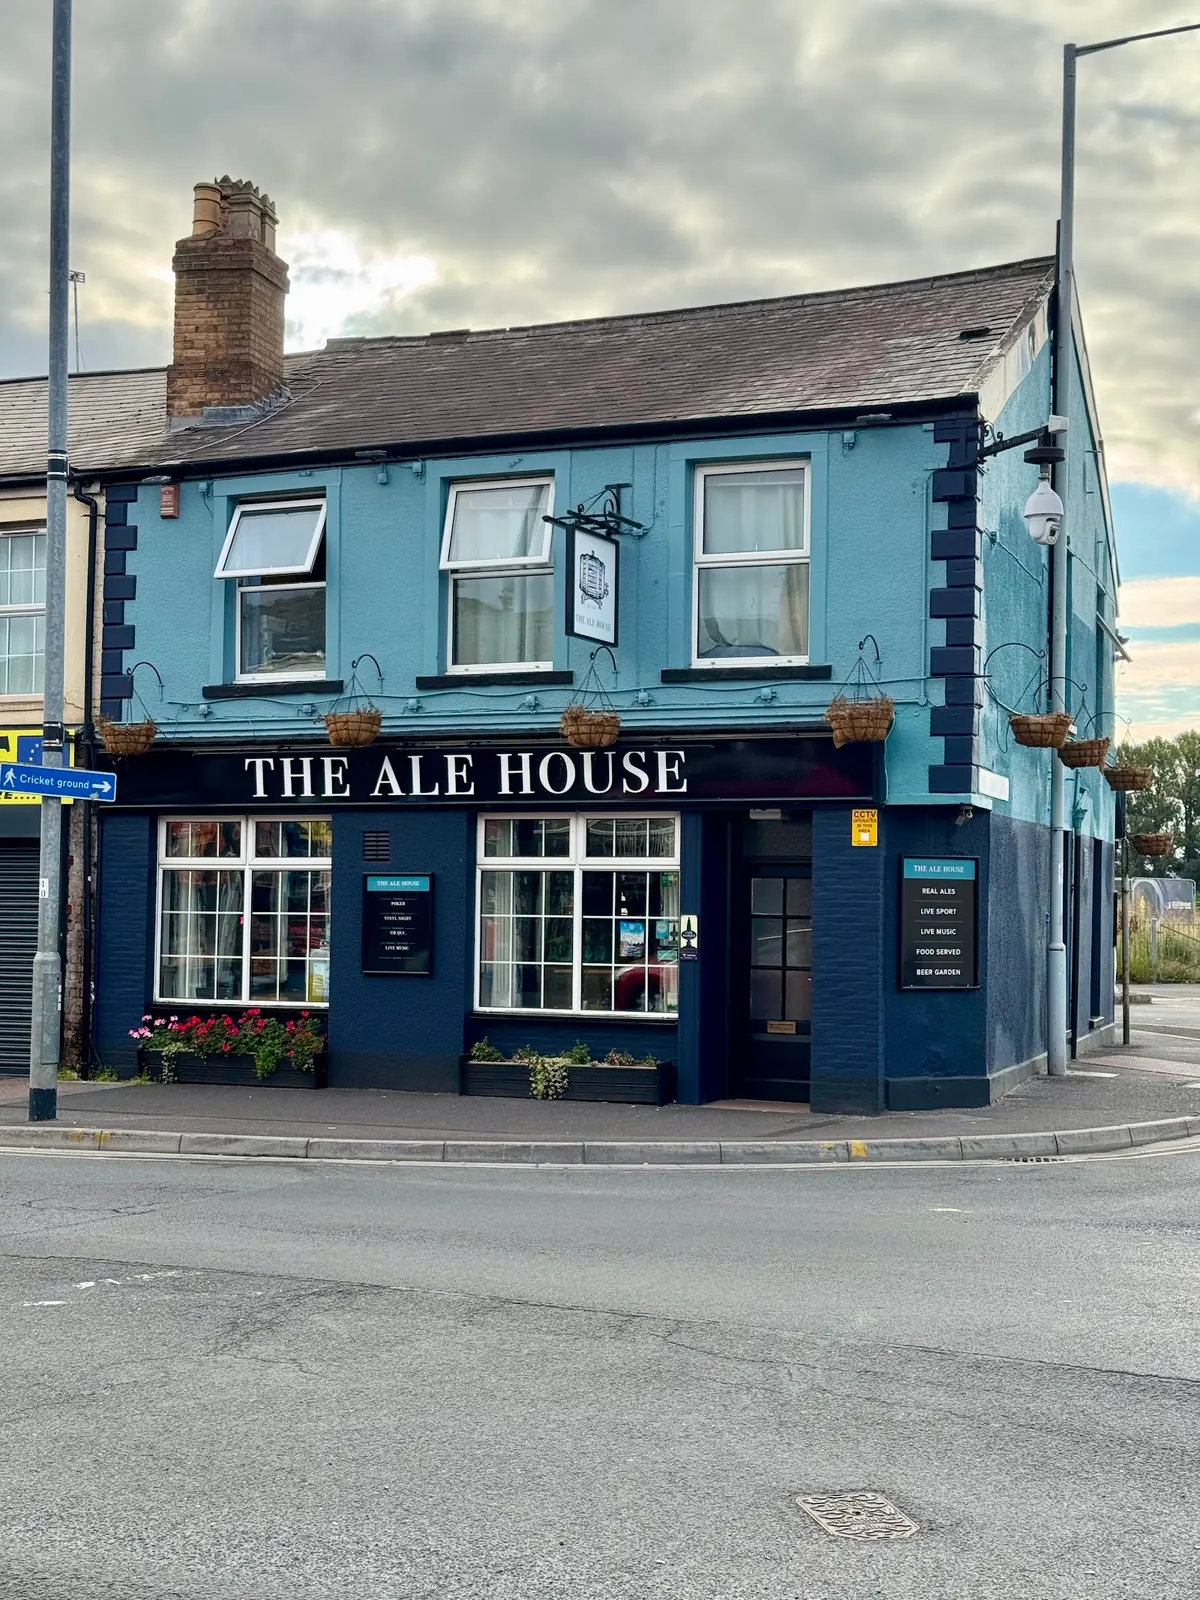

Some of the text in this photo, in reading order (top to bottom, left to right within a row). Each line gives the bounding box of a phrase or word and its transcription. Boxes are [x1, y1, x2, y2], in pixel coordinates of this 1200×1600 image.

[576, 614, 585, 625] THE
[586, 617, 595, 627] ALE
[244, 750, 688, 798] THE ALE HOUSE
[20, 774, 90, 789] Cricket ground
[928, 865, 942, 873] ALE
